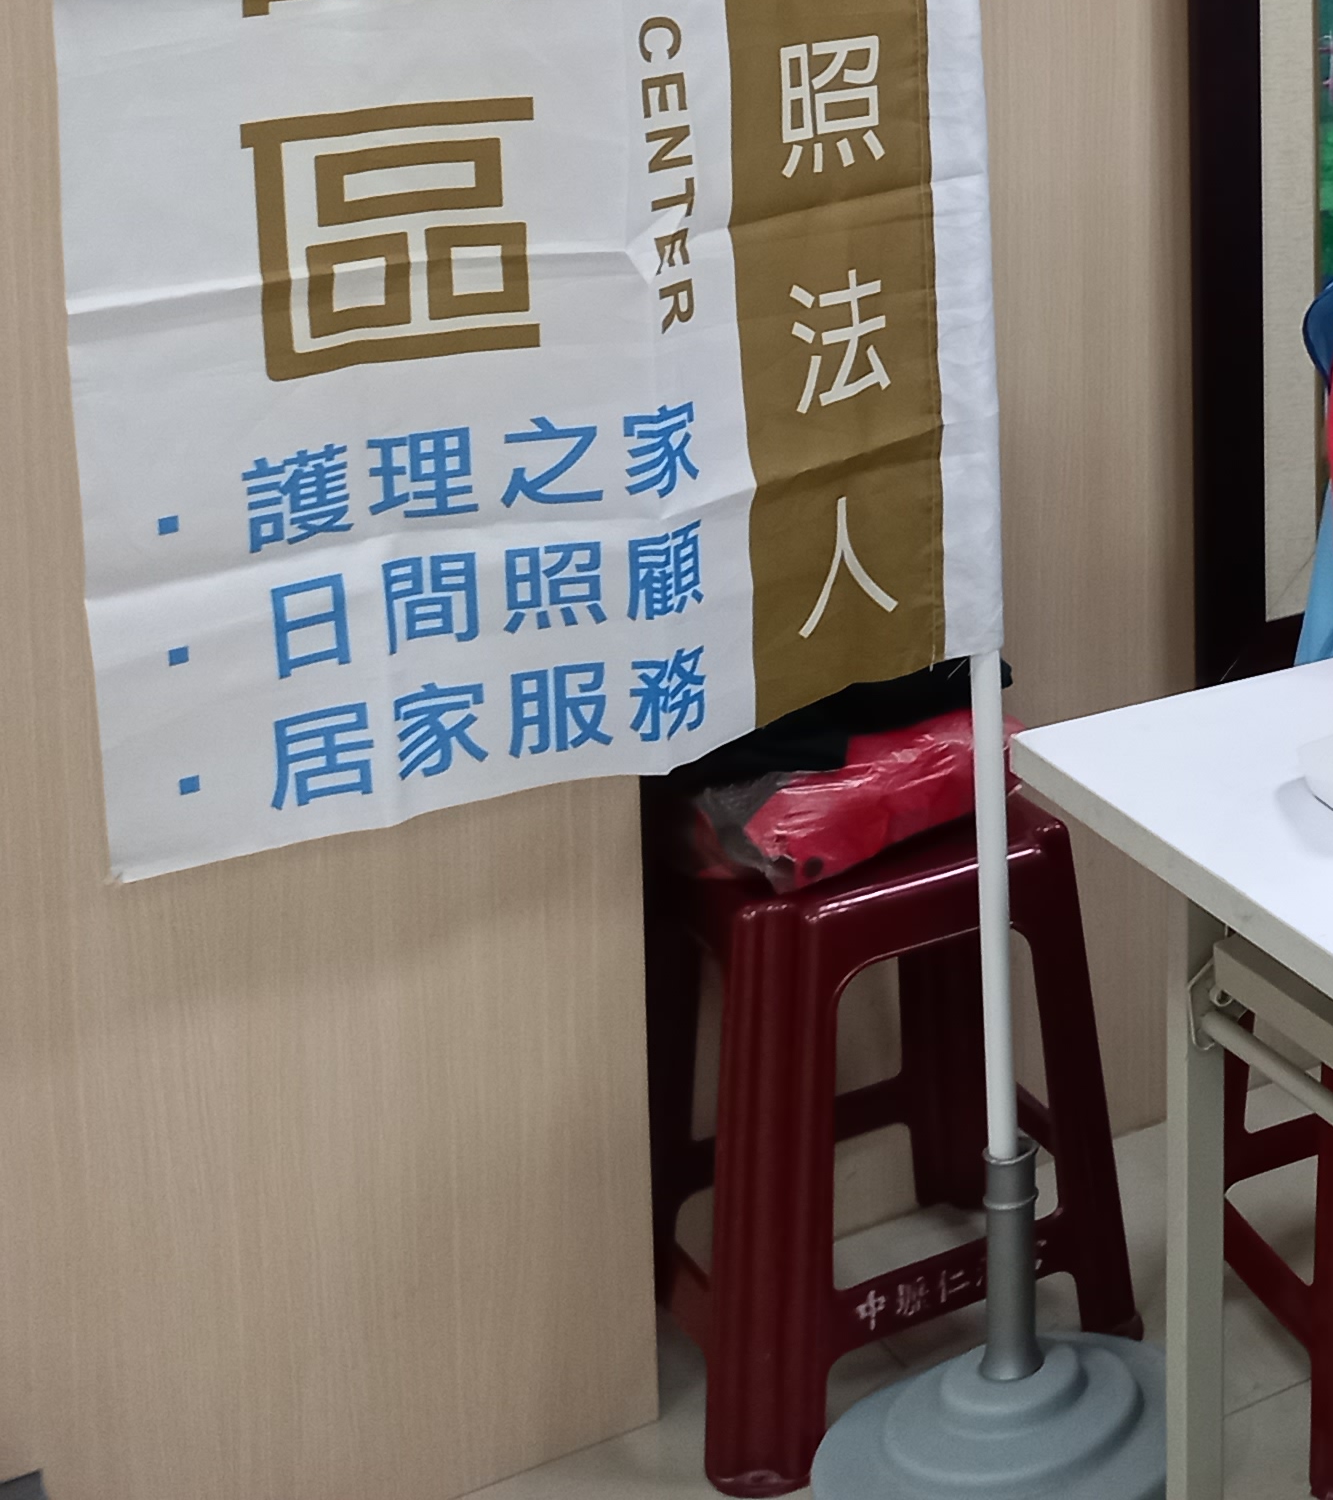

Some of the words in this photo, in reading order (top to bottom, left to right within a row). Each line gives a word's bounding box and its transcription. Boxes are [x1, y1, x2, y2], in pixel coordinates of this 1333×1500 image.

[638, 15, 697, 335] CENTER
[241, 399, 701, 554] 護理之家
[269, 519, 706, 681] 日間照顧
[269, 643, 708, 812] 居家服務
